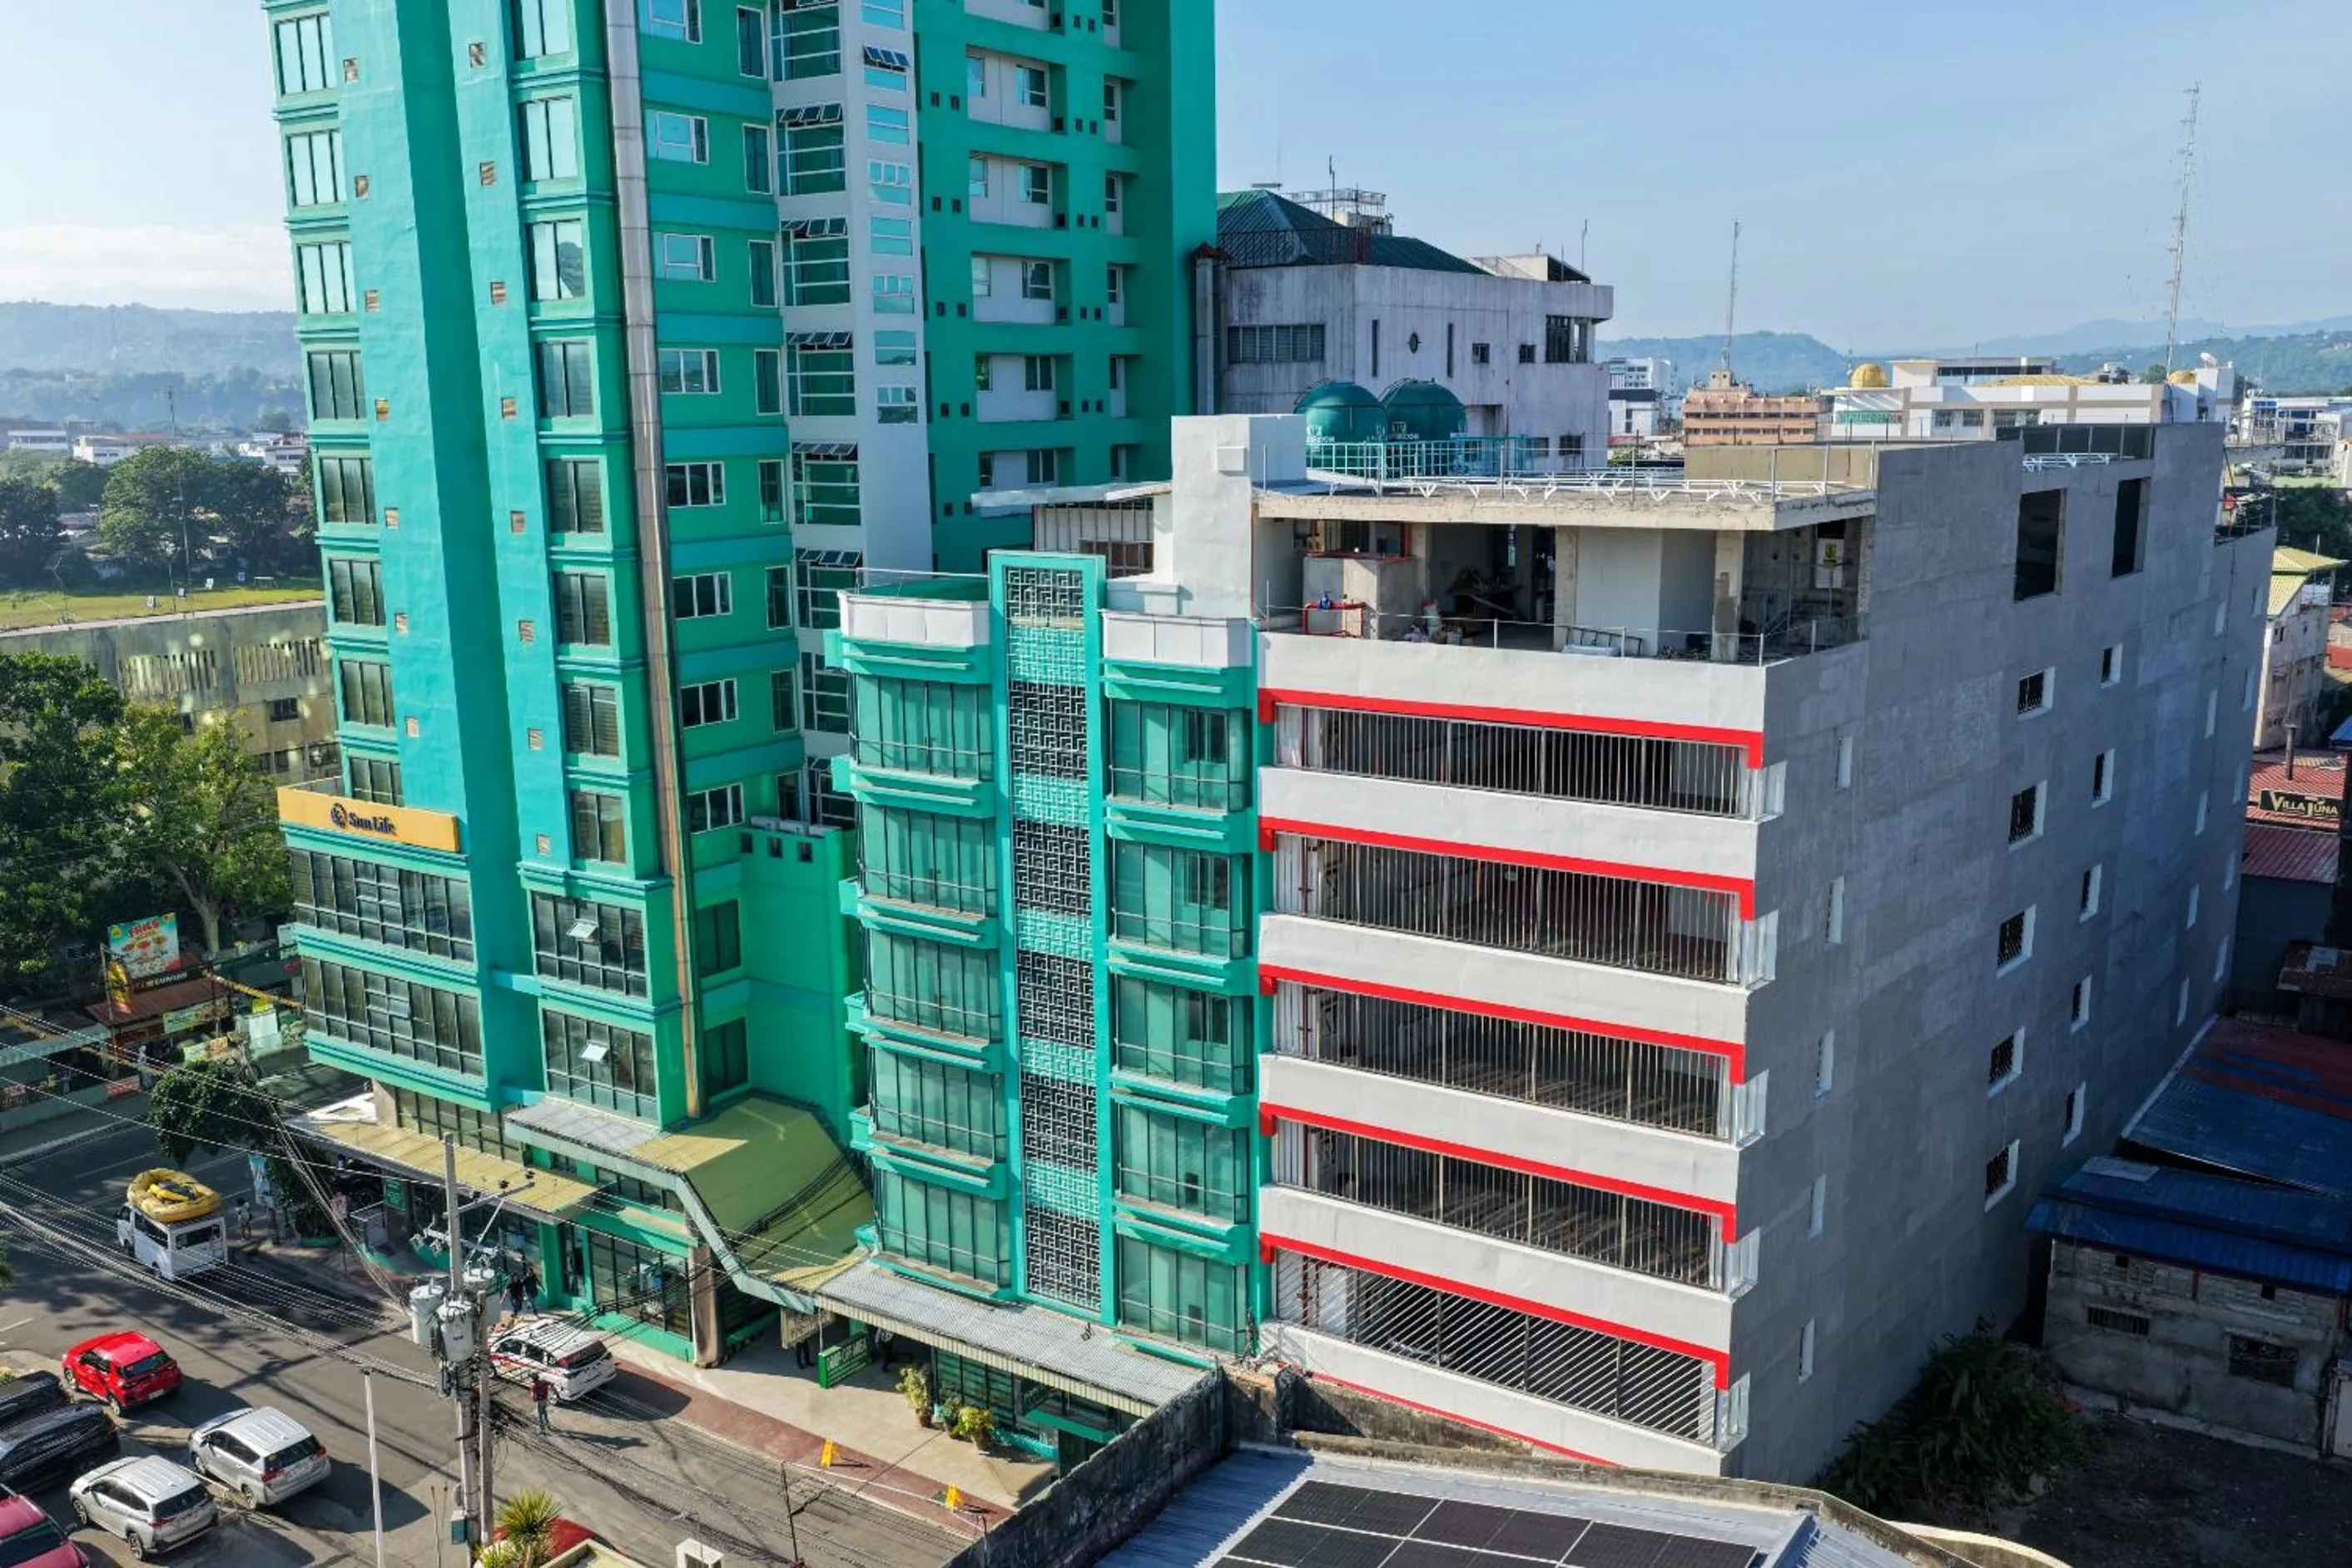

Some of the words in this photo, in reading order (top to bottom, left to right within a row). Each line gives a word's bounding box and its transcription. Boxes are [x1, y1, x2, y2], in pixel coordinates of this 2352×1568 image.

[2270, 791, 2305, 811] VILLA
[349, 811, 373, 830] Sun
[373, 816, 397, 834] Life
